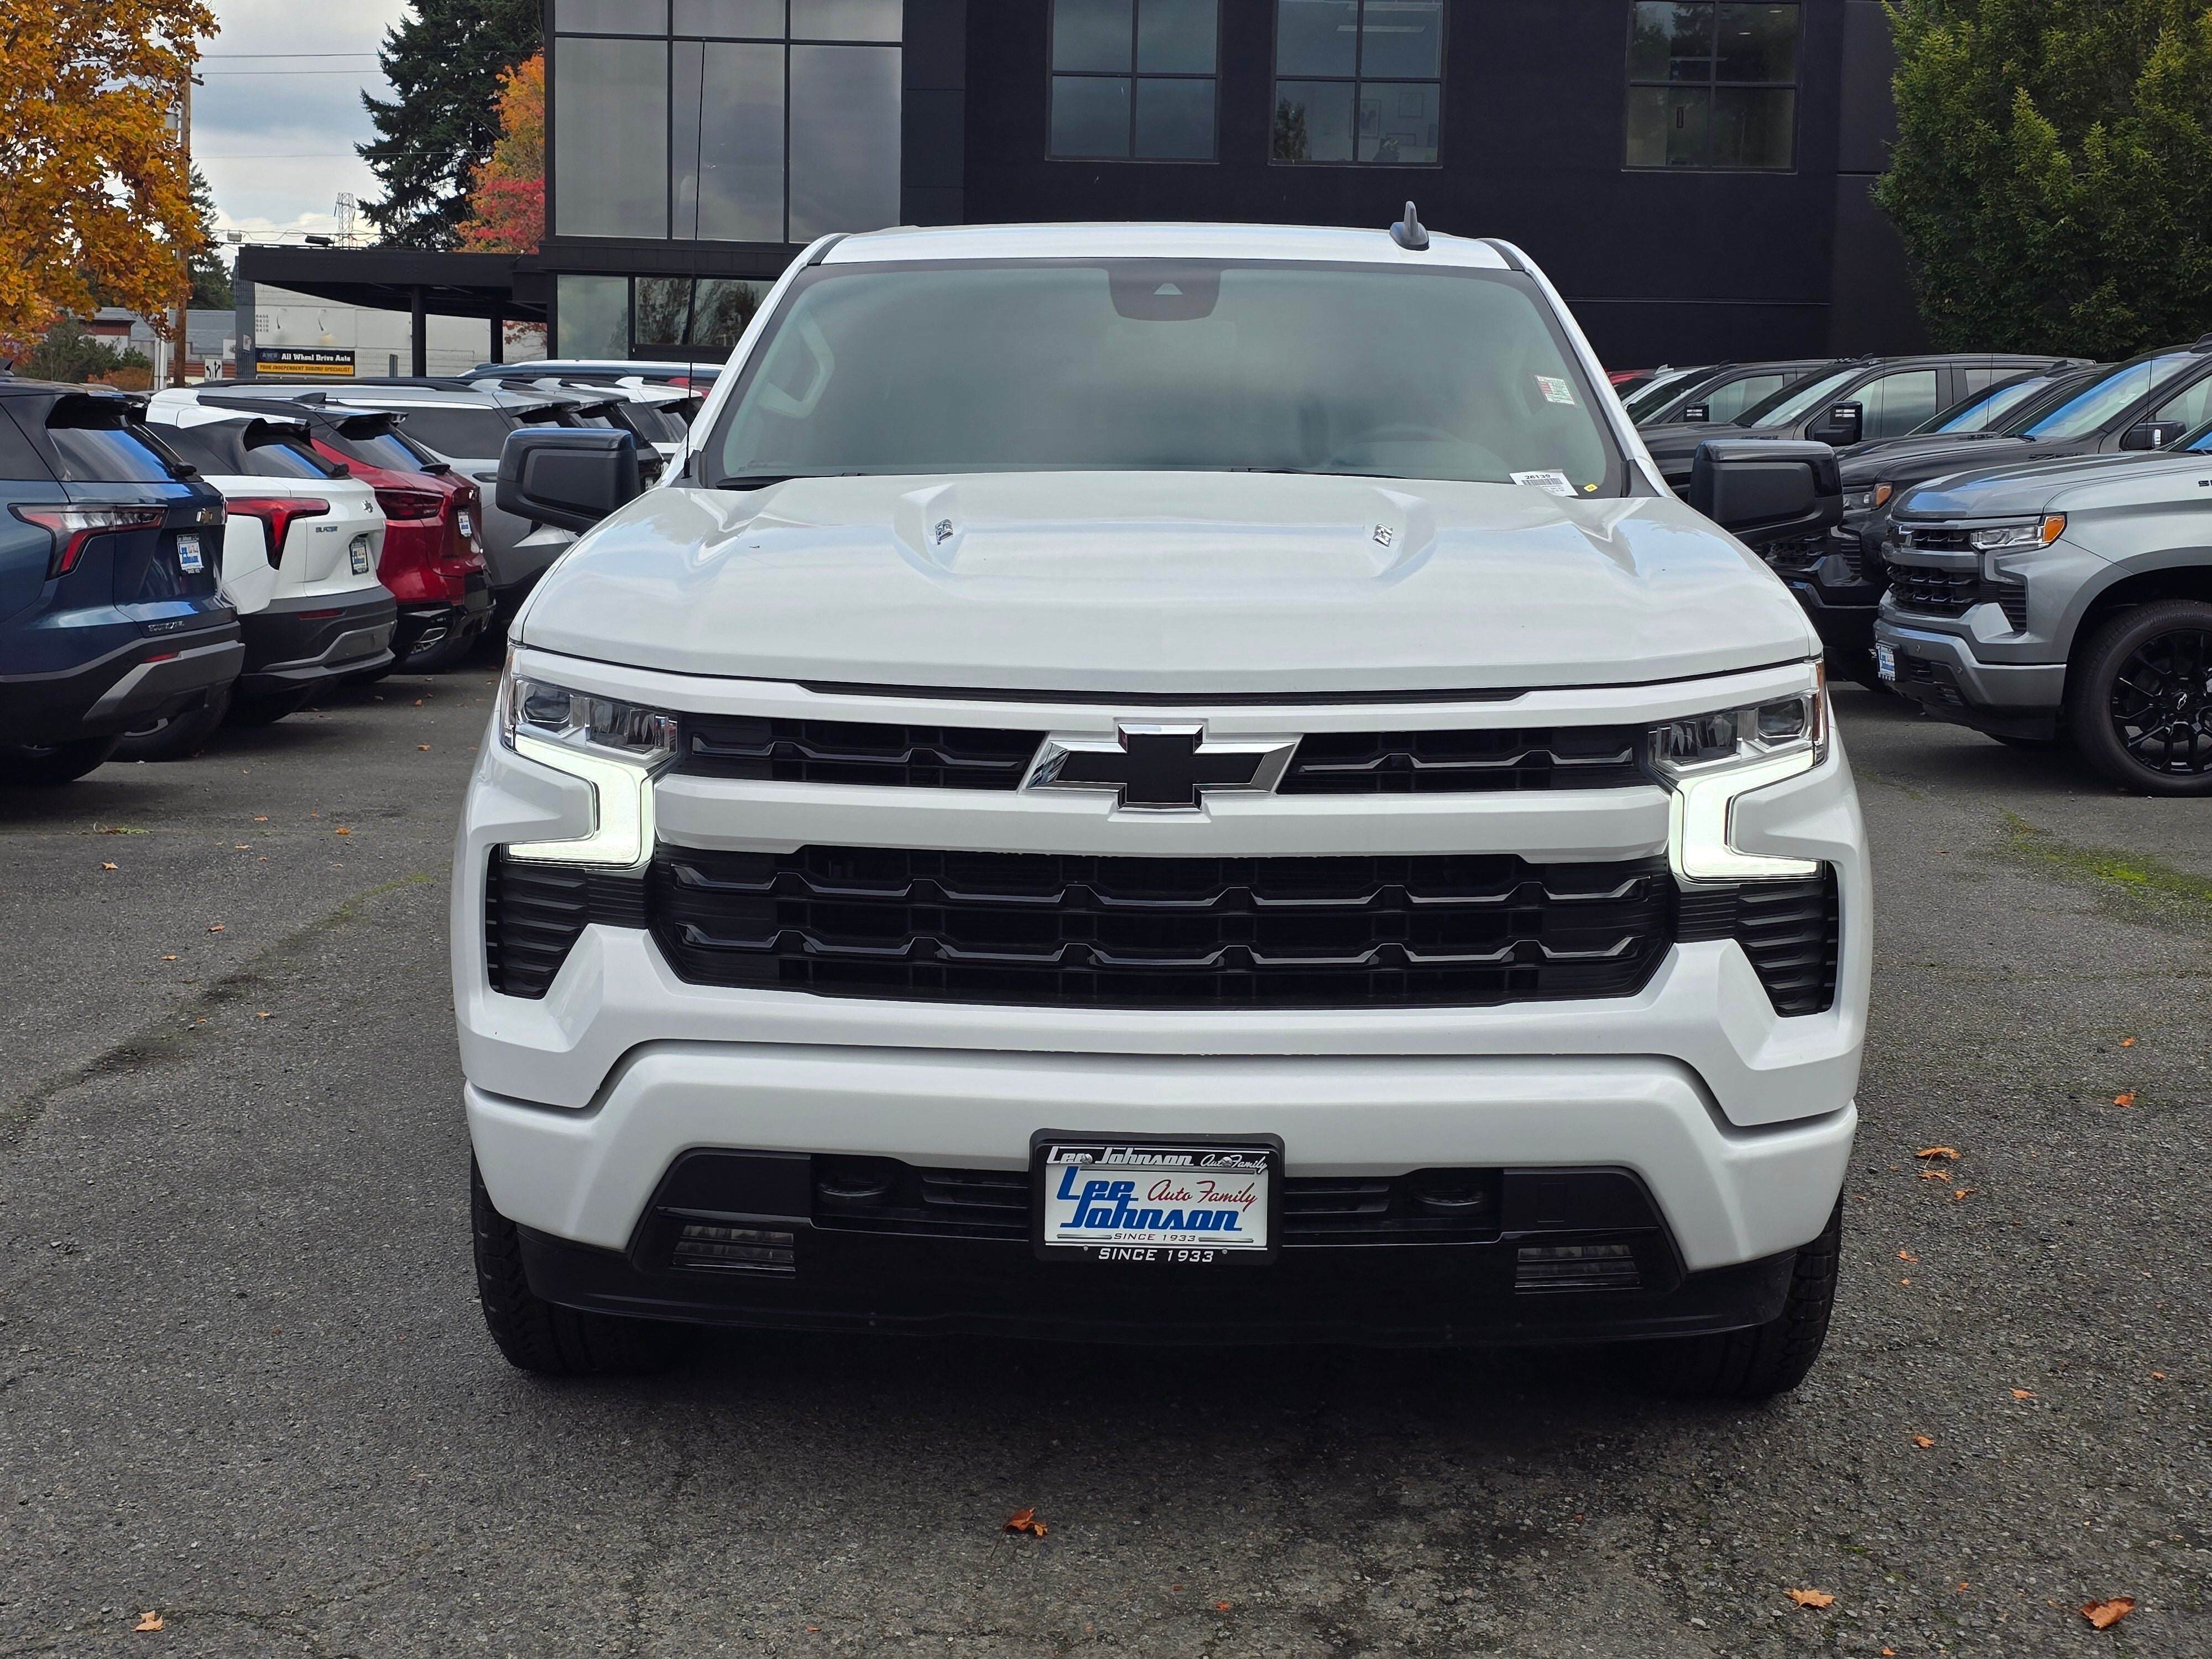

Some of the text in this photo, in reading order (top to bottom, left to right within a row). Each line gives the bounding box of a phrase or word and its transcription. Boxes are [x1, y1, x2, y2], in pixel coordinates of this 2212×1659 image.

[1095, 1147, 1194, 1166] Johnson
[1200, 1154, 1230, 1167] Aut
[1230, 1154, 1267, 1174] Family
[1056, 1166, 1139, 1201] Lee
[1147, 1179, 1258, 1213] Auto Family
[1060, 1192, 1243, 1232] Johnson
[1098, 1248, 1214, 1262] SINCE 1933
